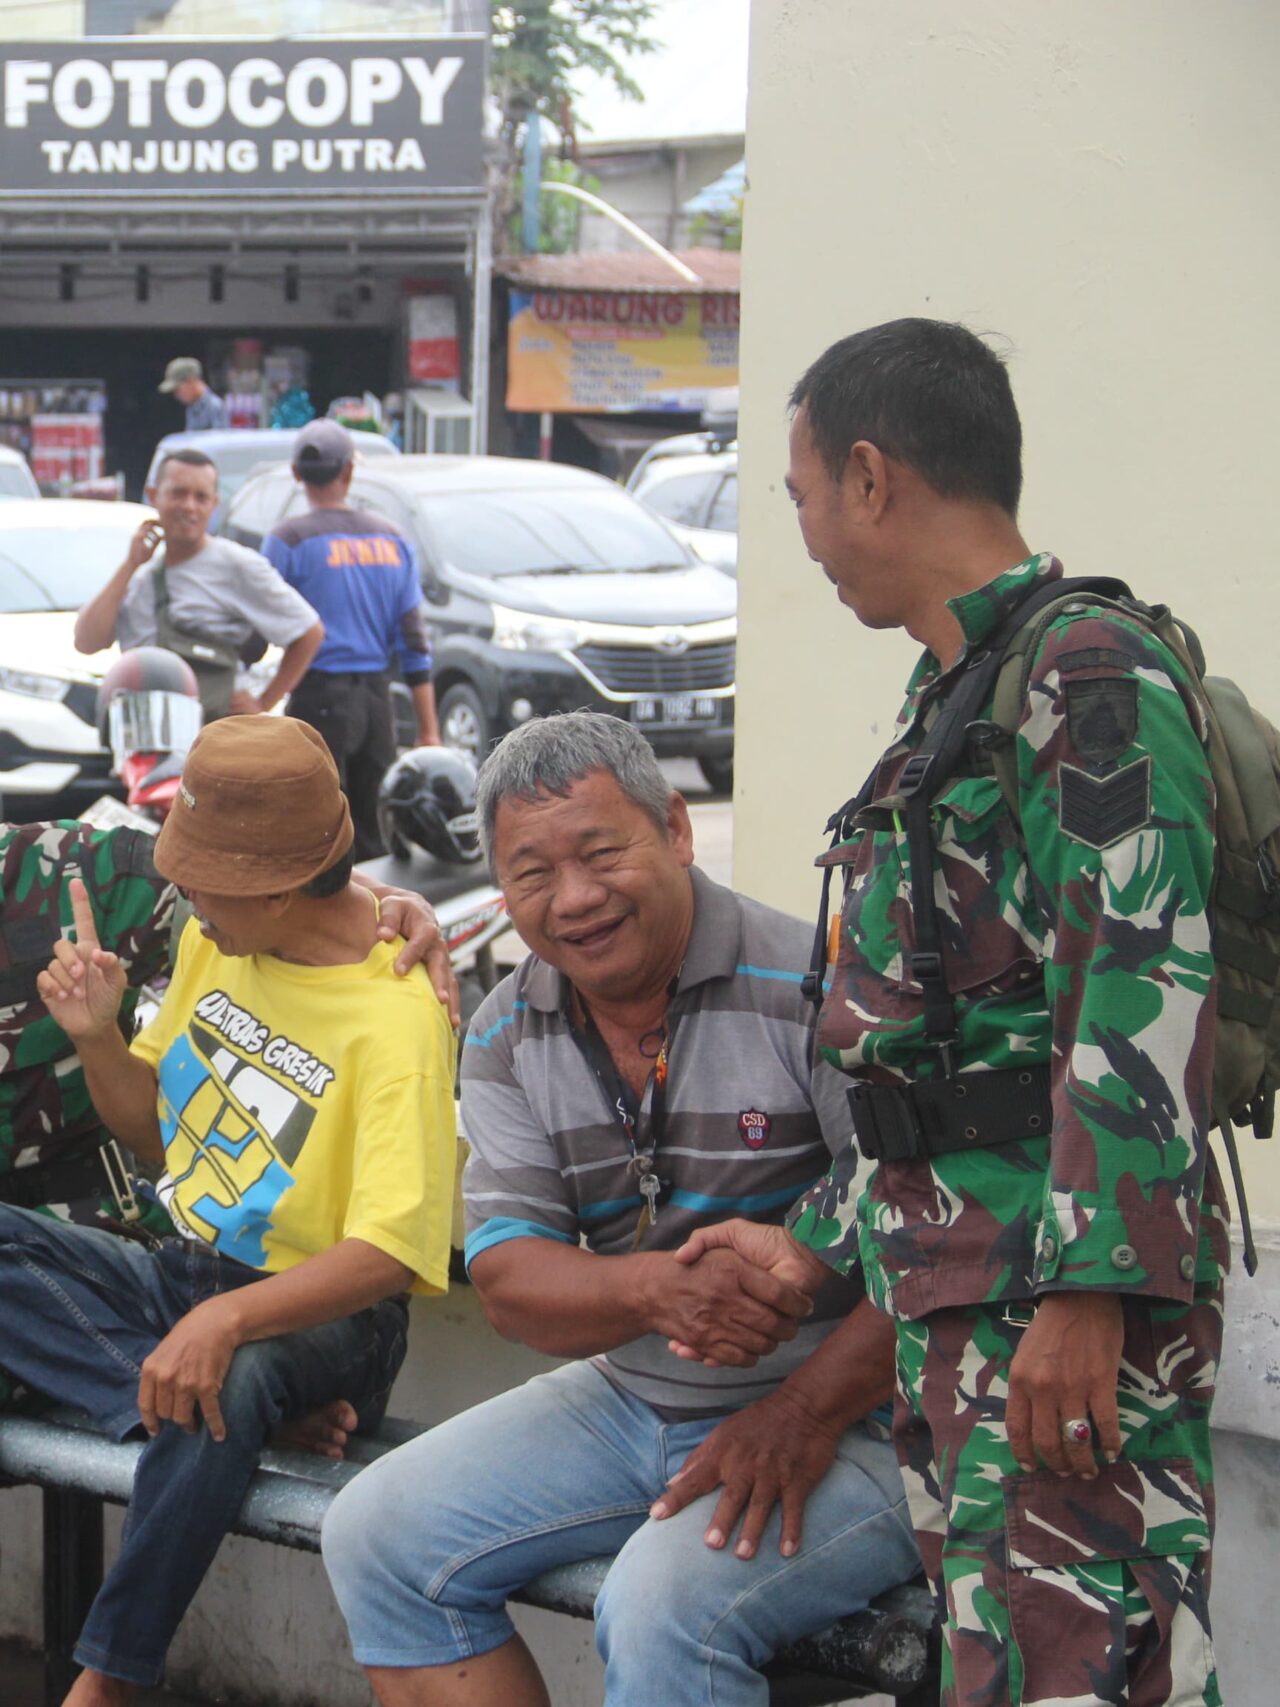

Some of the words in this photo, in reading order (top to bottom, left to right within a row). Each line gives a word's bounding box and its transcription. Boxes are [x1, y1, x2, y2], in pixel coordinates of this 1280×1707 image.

[4, 58, 464, 128] FOTOCOPY
[41, 139, 258, 173] TANJUNG
[273, 138, 426, 172] PUTRA
[533, 293, 686, 325] WARUNG
[194, 989, 269, 1053] ULTRAS
[262, 1034, 335, 1098] GRESIK
[742, 1112, 766, 1126] CSD
